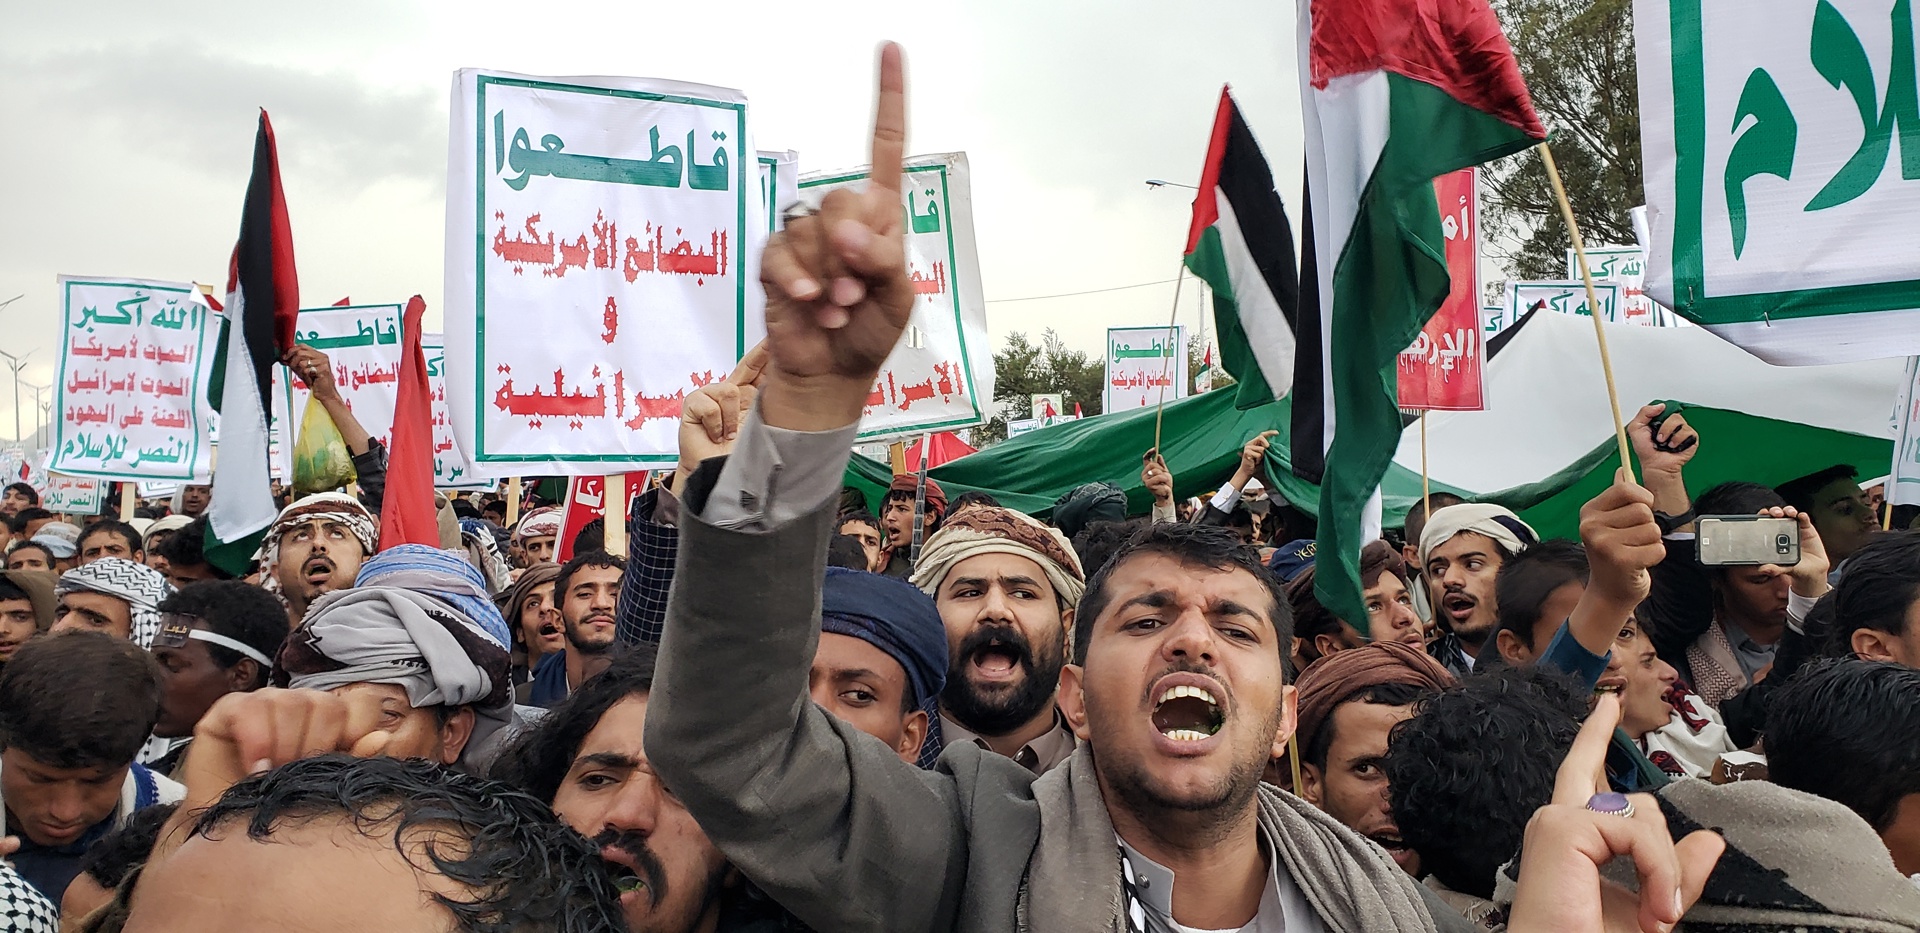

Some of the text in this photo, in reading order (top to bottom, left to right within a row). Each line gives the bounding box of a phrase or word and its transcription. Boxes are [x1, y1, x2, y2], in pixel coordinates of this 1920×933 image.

[493, 109, 729, 192] قاطعوا
[492, 207, 728, 287] البضائع الأمريكية
[72, 291, 198, 333] الله أكبر
[601, 296, 618, 345] و
[71, 334, 194, 365] الموت لأمريكا
[1111, 337, 1175, 364] قاطعوا
[67, 367, 189, 399] الموت لإسرائيل
[1111, 367, 1174, 391] البضائع الأمريكية
[66, 402, 115, 427] اليهود
[119, 404, 144, 430] على
[151, 406, 191, 429] اللعنة
[60, 431, 190, 469] النصر للإسلام
[434, 435, 453, 454] على
